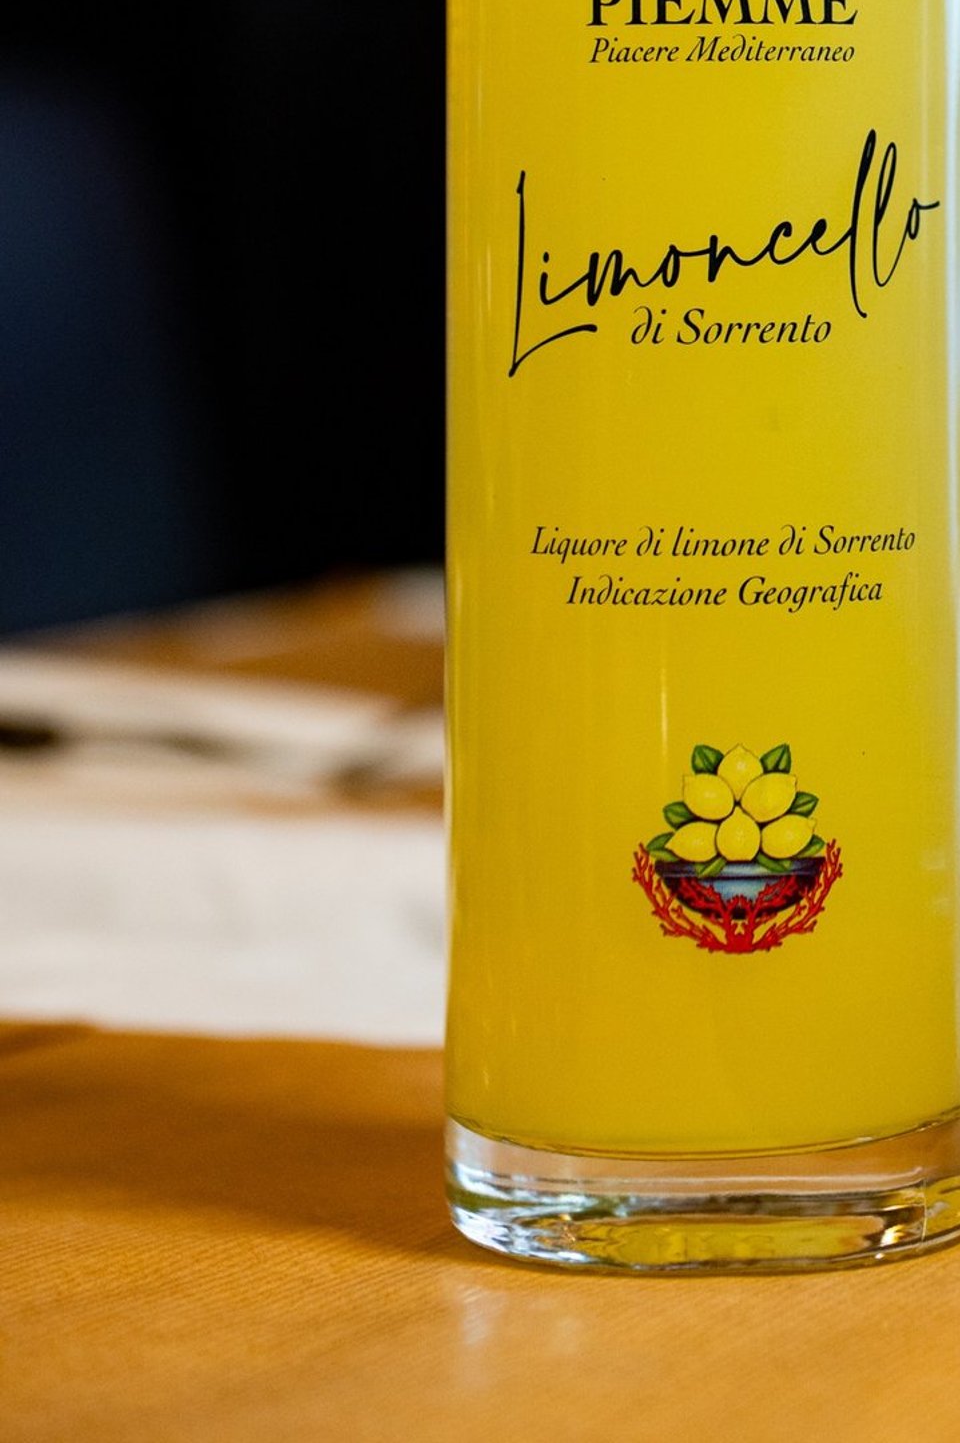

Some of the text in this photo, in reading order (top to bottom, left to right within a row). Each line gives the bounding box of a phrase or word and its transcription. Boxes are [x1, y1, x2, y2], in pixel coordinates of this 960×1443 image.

[589, 34, 855, 64] Piacere Mediterraneo
[507, 128, 941, 379] Limoncello
[630, 305, 832, 346] di Sorrento
[530, 524, 916, 565] Liquore di limone di Sorrento
[566, 571, 883, 614] Indicazione Geografica
